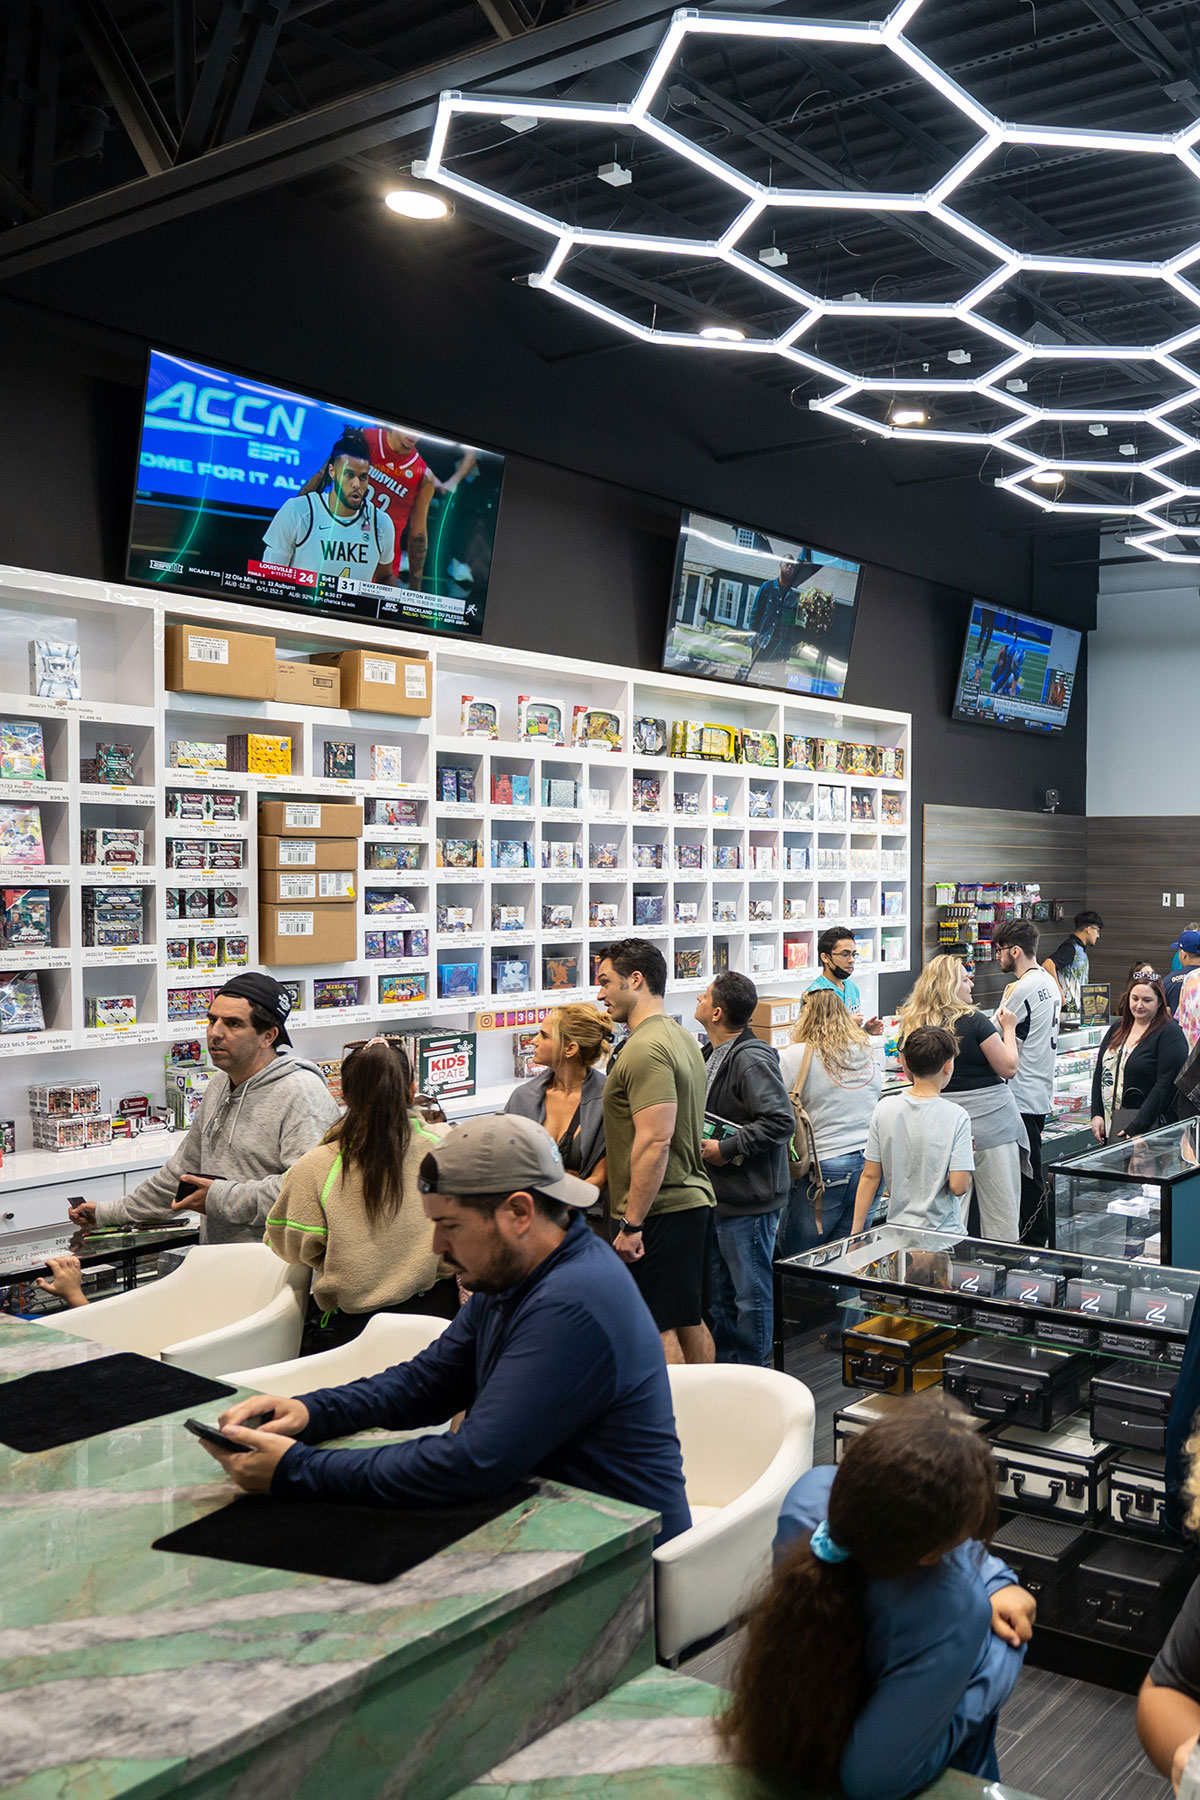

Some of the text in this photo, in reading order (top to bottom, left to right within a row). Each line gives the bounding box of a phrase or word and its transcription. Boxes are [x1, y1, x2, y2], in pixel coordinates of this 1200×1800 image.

[145, 380, 306, 442] ACCN
[247, 441, 299, 466] ESPN
[197, 461, 245, 482] FOR
[249, 471, 269, 485] IT
[320, 540, 369, 564] WAKE
[188, 567, 209, 576] NCAAM
[259, 562, 314, 584] LOUISVILLE 24
[244, 576, 257, 584] Miss
[274, 581, 296, 591] Auburn
[341, 580, 355, 591] 31
[362, 582, 376, 590] WAKE
[402, 605, 433, 615] STRICKLAND
[431, 1054, 466, 1072] KID'S
[431, 1067, 465, 1083] CRATE
